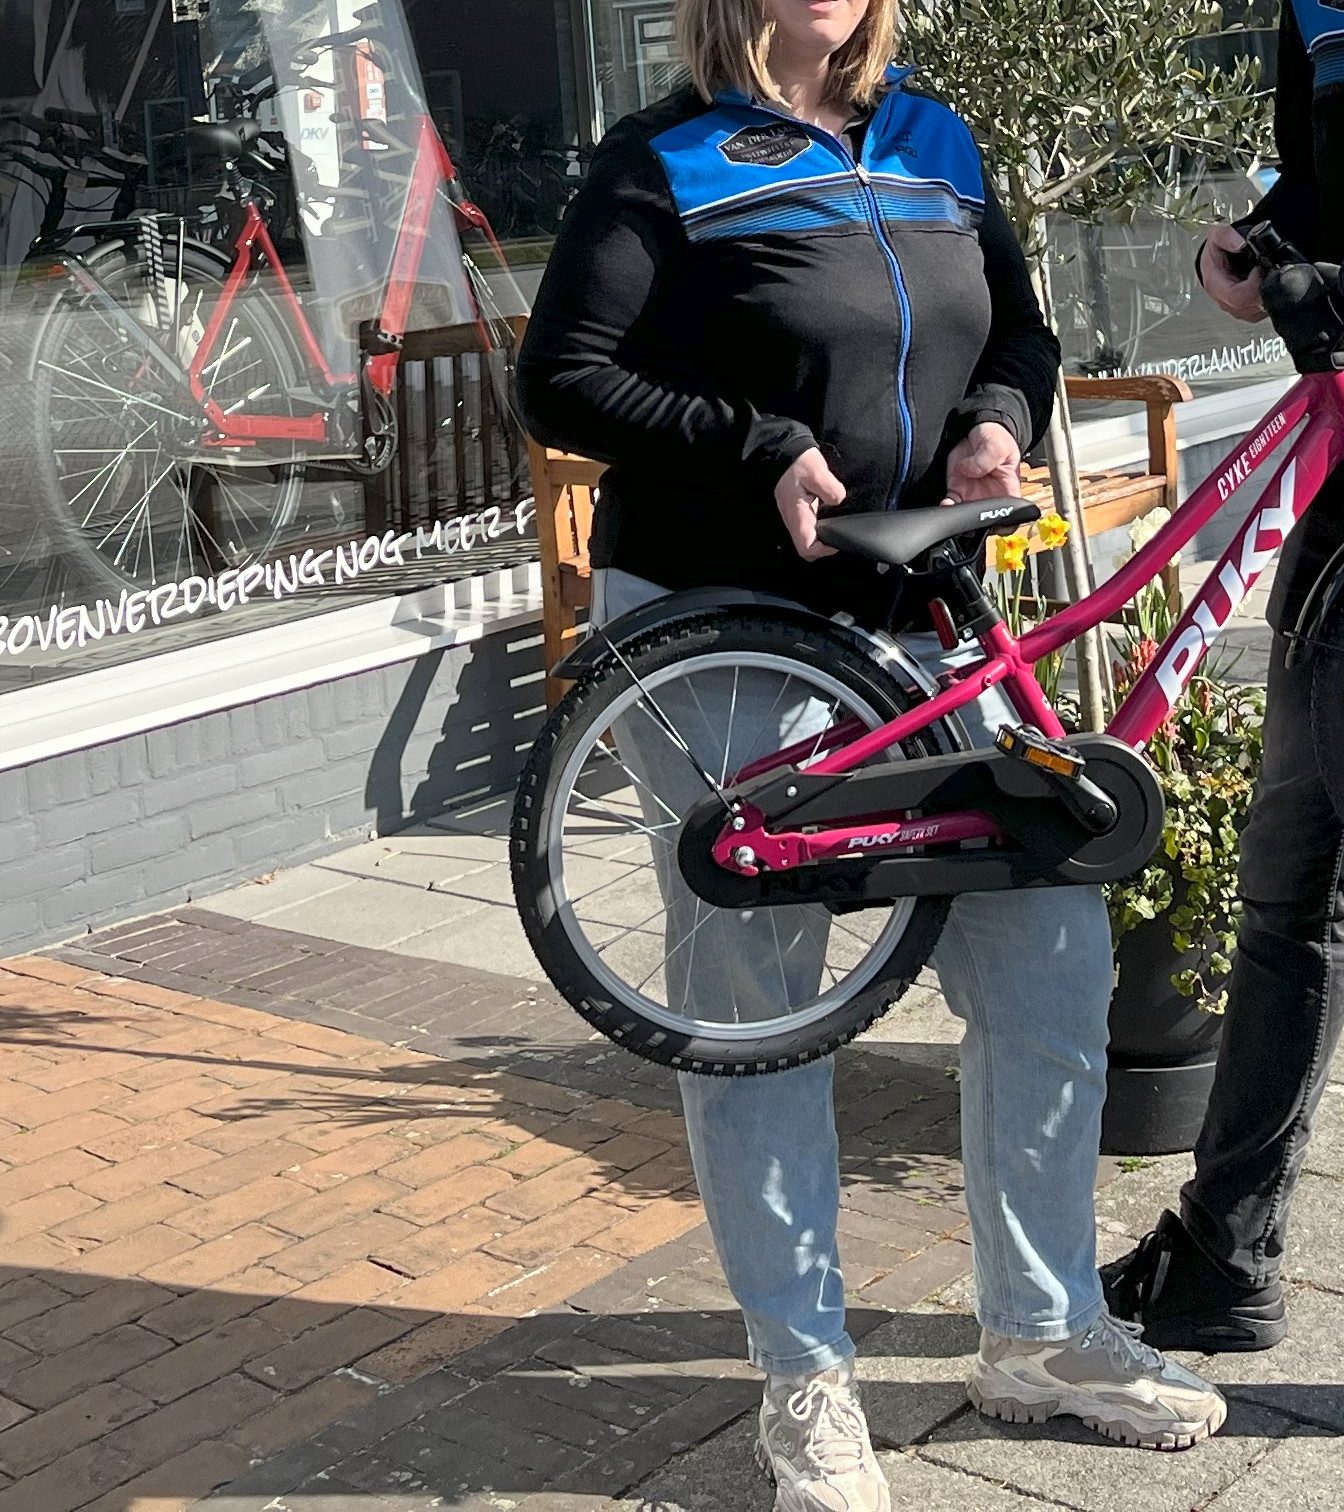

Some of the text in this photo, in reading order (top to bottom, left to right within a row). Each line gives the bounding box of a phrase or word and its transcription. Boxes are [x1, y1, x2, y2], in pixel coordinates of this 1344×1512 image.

[1217, 451, 1252, 501] CYKE
[980, 506, 1014, 521] PUKY
[336, 530, 411, 584] NOG
[416, 505, 506, 558] MEER
[1155, 456, 1297, 709] PUKY
[847, 831, 900, 849] PUKY
